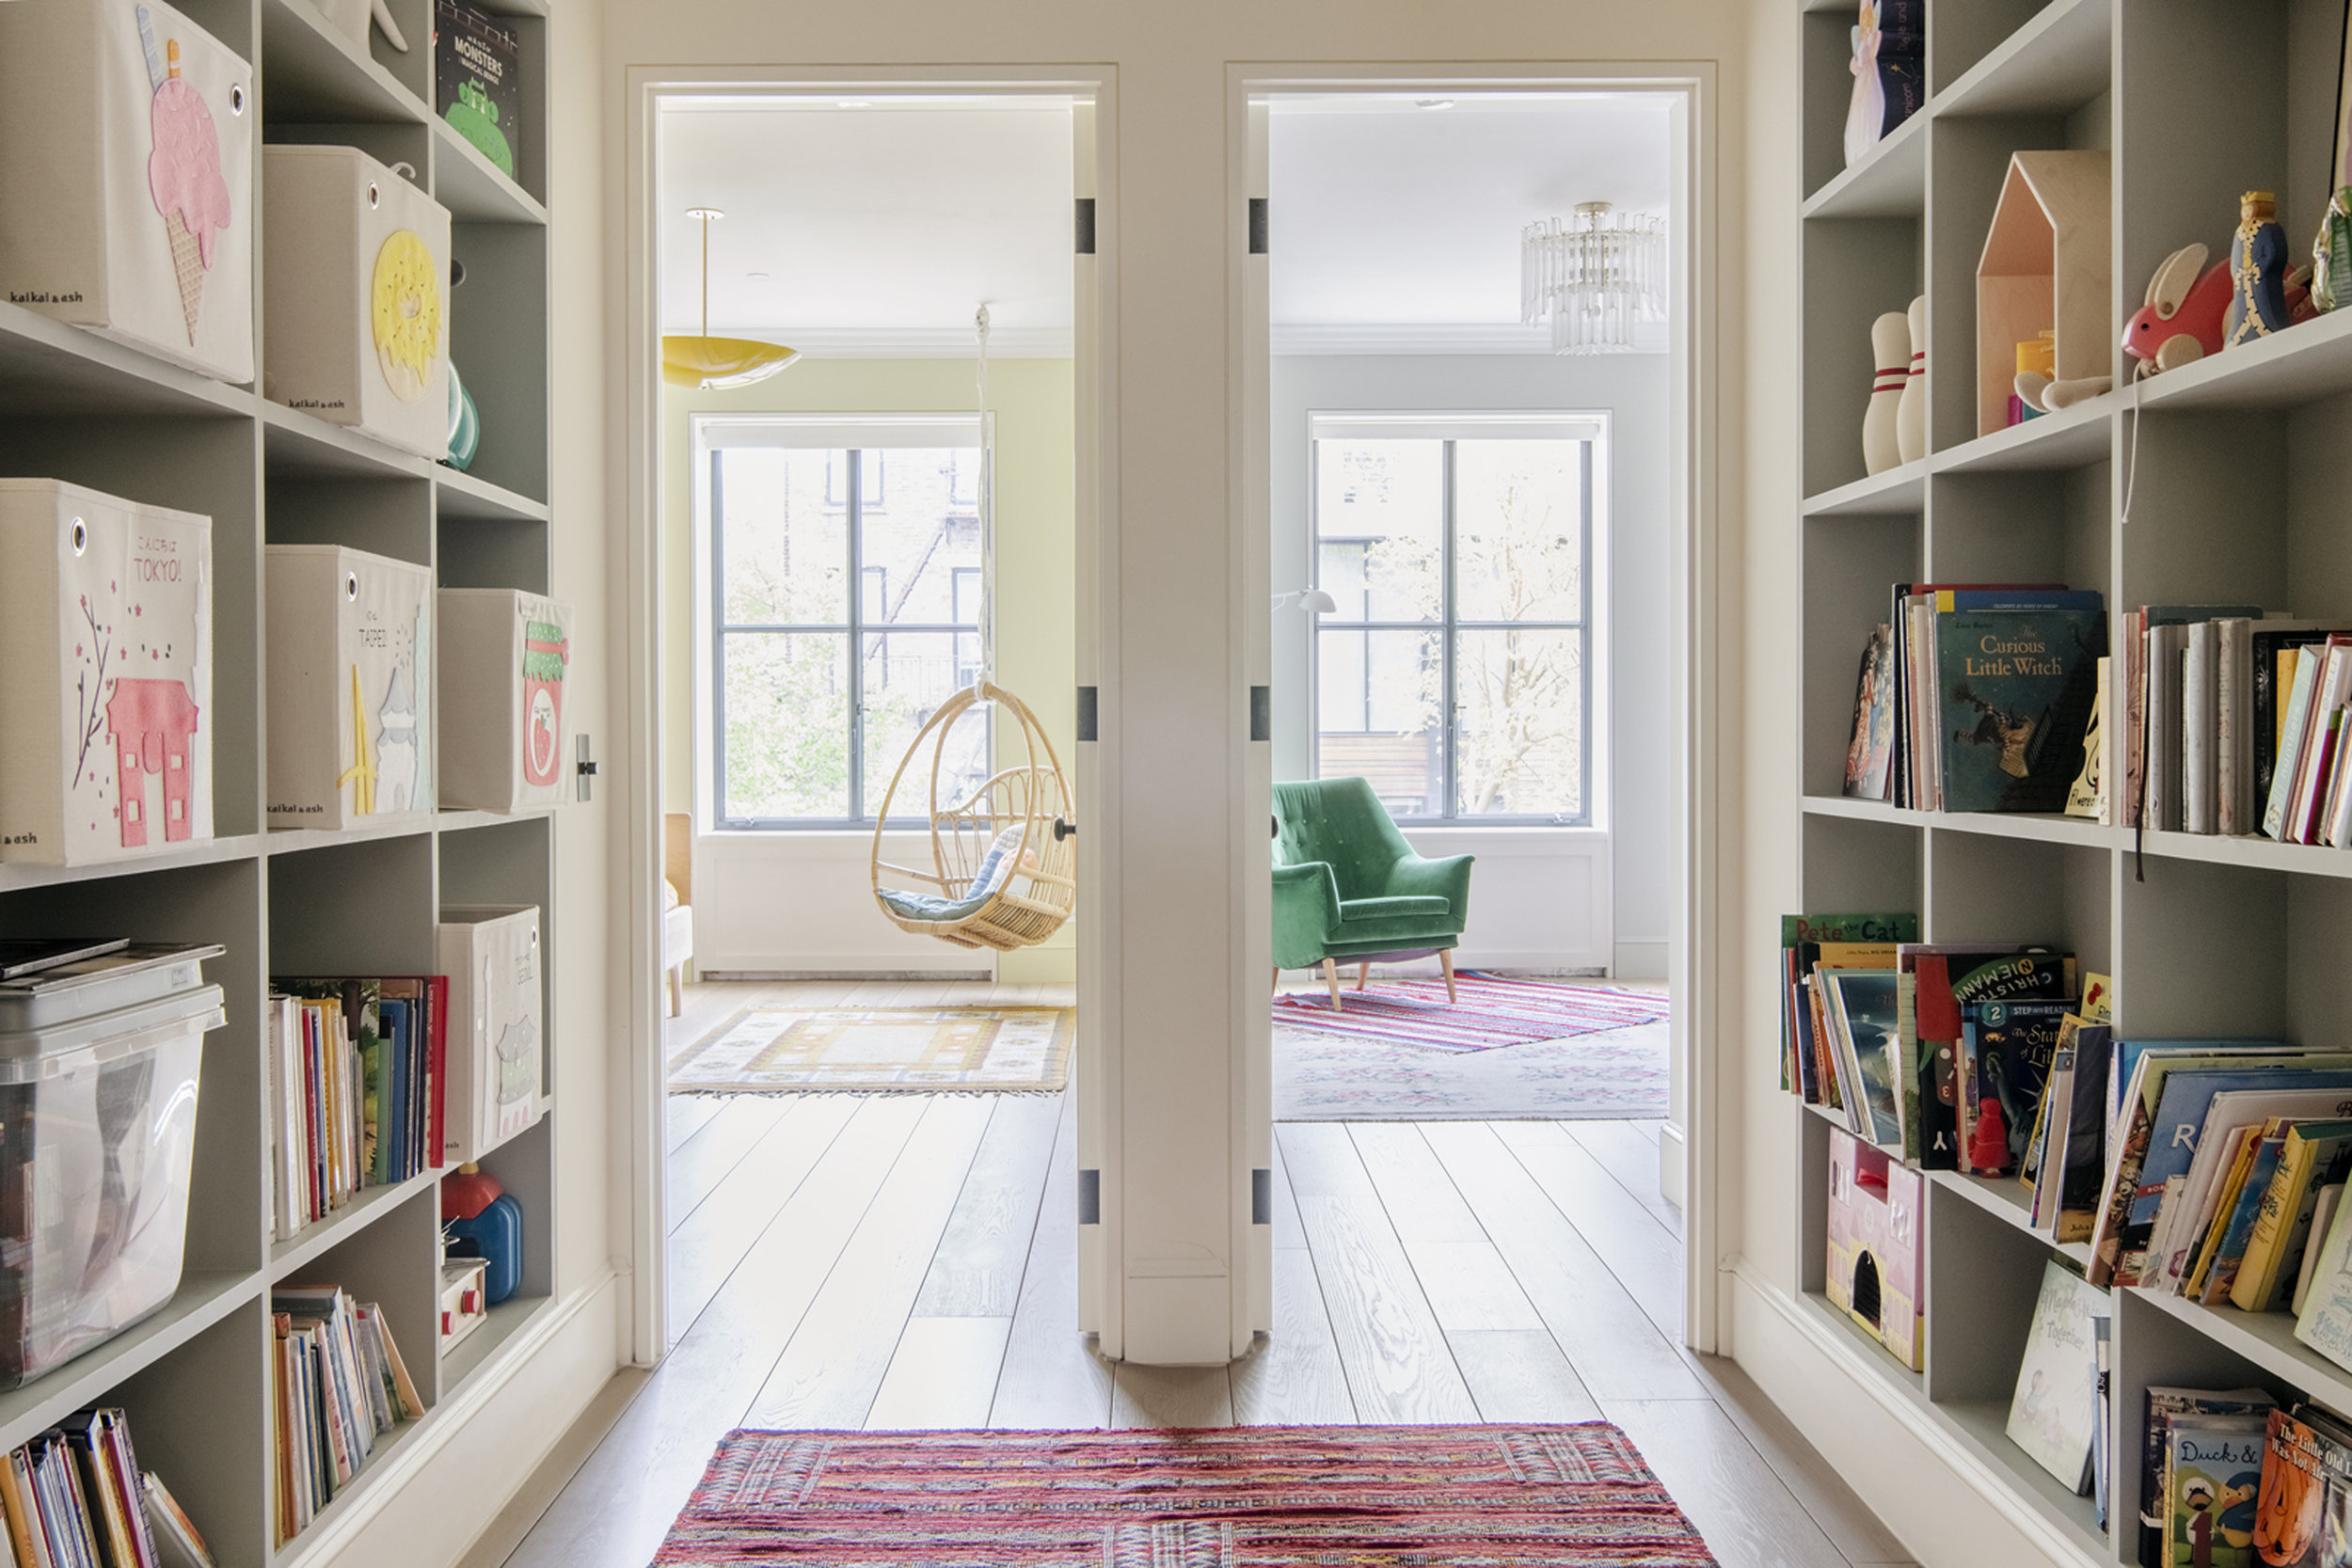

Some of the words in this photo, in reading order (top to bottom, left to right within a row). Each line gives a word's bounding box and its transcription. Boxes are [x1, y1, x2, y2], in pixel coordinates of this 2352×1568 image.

[454, 36, 502, 77] MONSTERS
[10, 291, 49, 302] kaikai
[61, 291, 83, 302] ash
[289, 399, 319, 407] kaikai
[327, 399, 345, 408] ash
[134, 558, 182, 582] TOKYO!
[1980, 634, 2045, 654] Curious
[1966, 657, 2011, 676] Little
[2012, 657, 2062, 676] Witch
[306, 803, 324, 813] ash
[14, 832, 38, 844] ash
[1796, 918, 1843, 941] Pete
[1861, 920, 1900, 941] Cat
[1955, 959, 2032, 1005] NIEMANN
[1978, 971, 2053, 1002] CHRISTO
[1991, 1006, 2001, 1021] 2
[2013, 1006, 2032, 1016] STEP
[2047, 1320, 2085, 1352] Together
[2181, 1440, 2238, 1464] Duck
[2241, 1445, 2258, 1464] &
[2272, 1437, 2289, 1461] Was
[2292, 1450, 2308, 1471] Not
[2280, 1423, 2296, 1444] The
[2298, 1434, 2323, 1460] Little
[2325, 1450, 2344, 1472] Old
